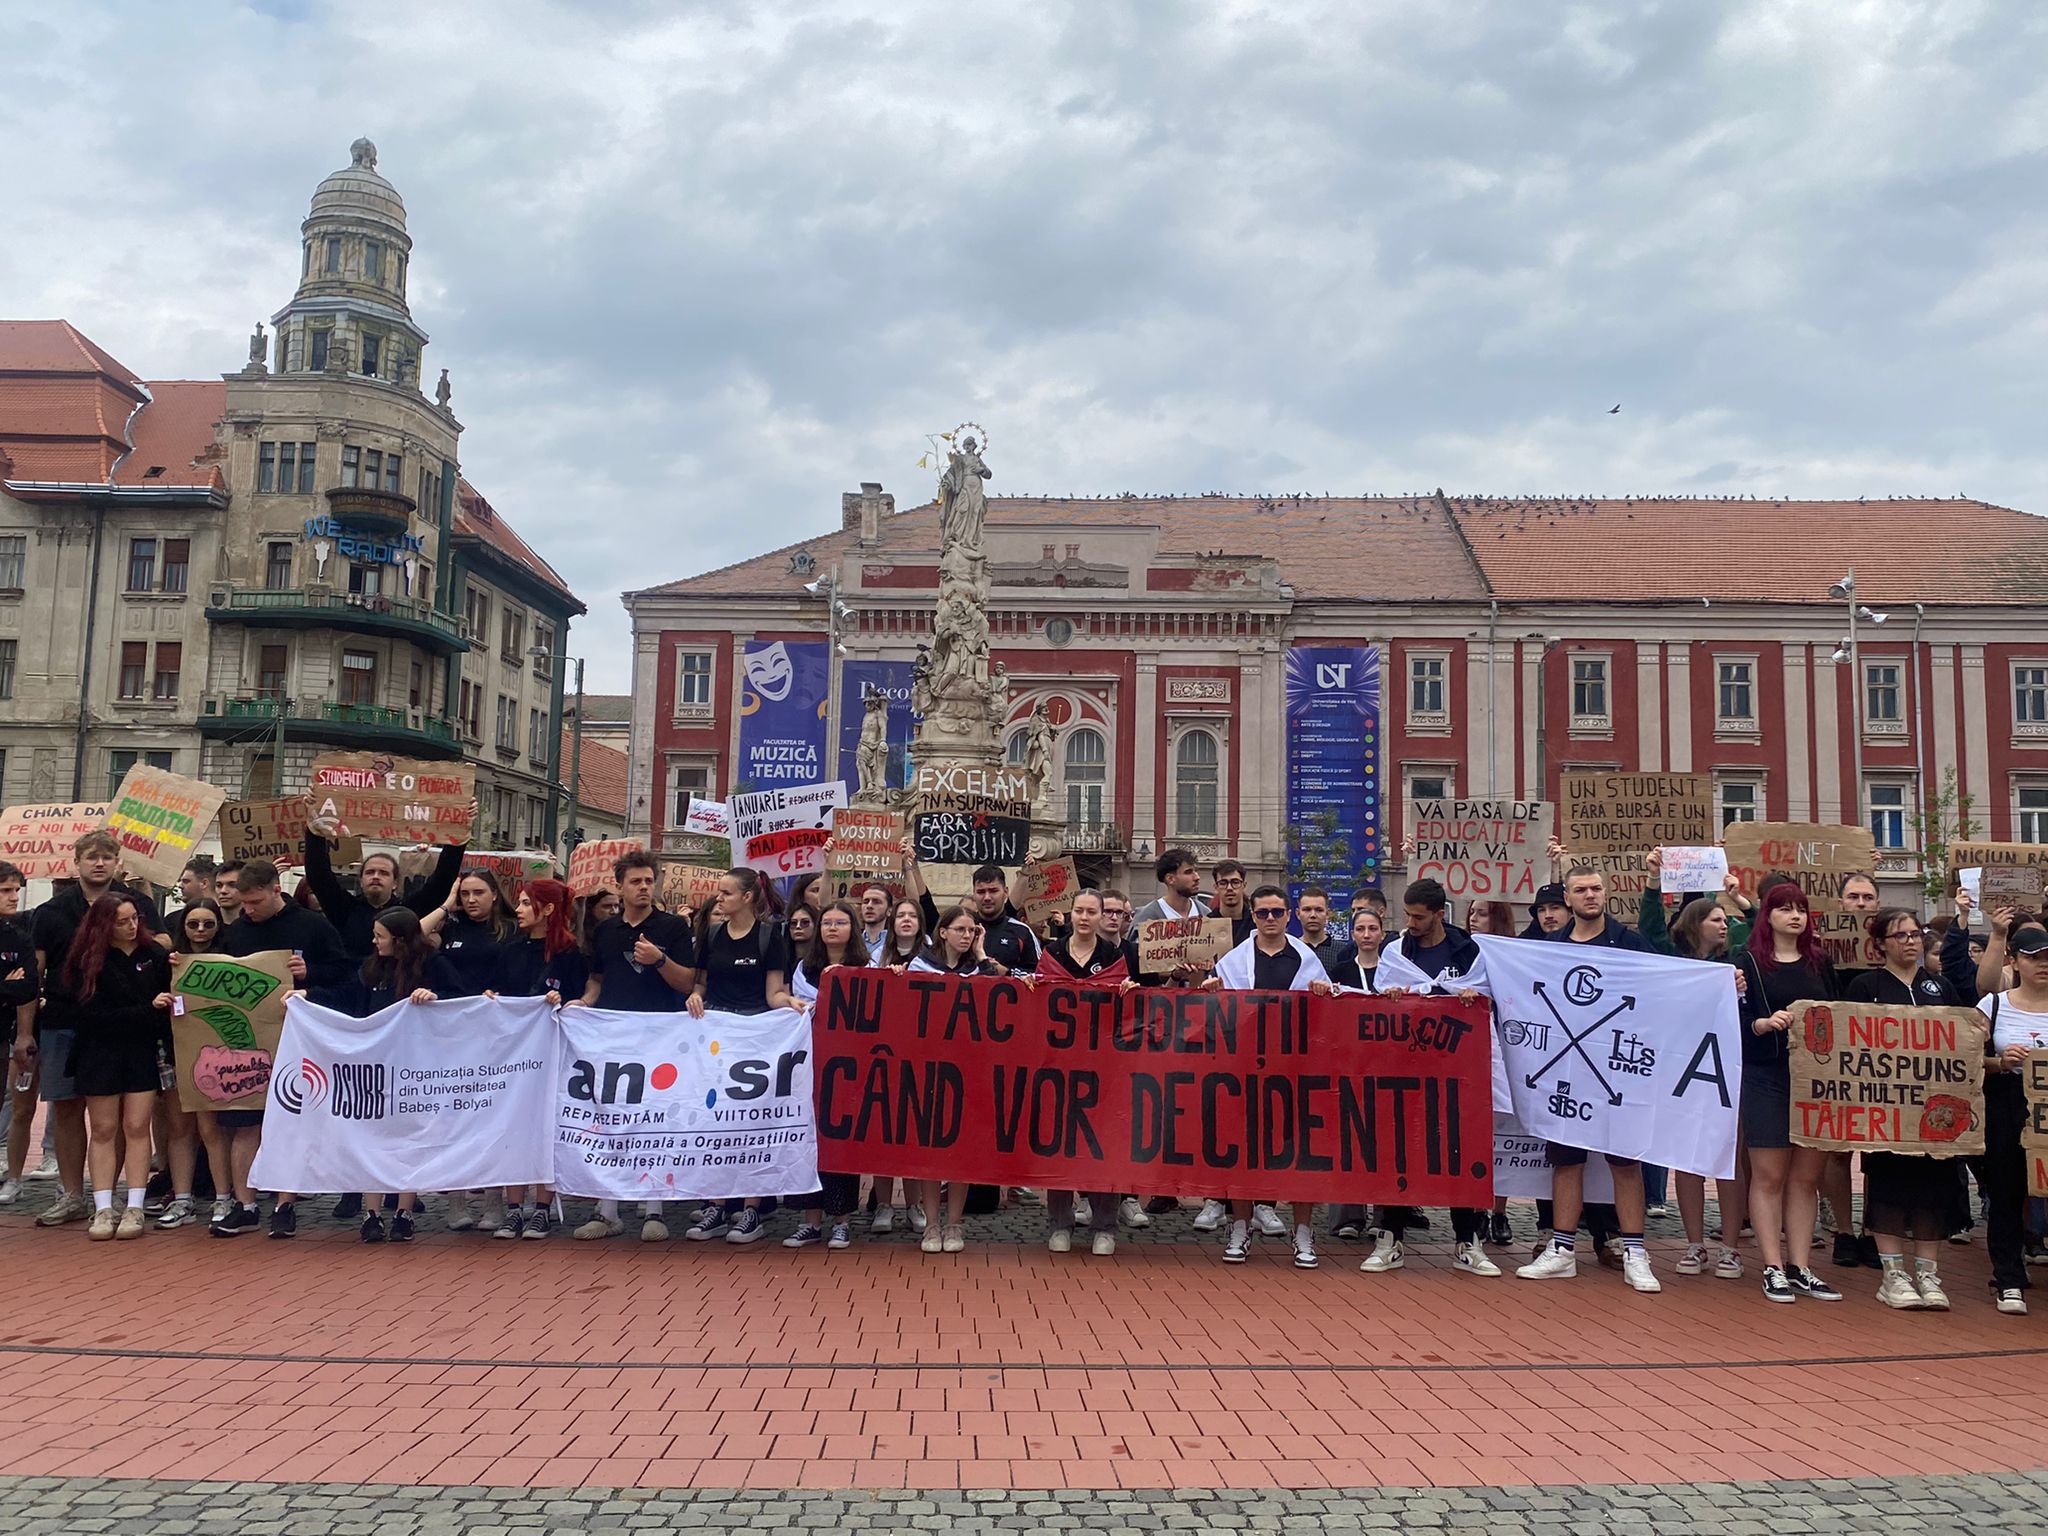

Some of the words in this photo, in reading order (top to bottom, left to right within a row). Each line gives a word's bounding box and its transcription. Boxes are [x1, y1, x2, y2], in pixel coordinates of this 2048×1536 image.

[750, 745, 817, 762] MUZICĂ
[753, 763, 818, 779] TEATRU
[385, 773, 397, 790] E
[401, 775, 415, 791] O
[918, 768, 1030, 802] EXCELĂM
[1569, 780, 1596, 798] UN
[1607, 777, 1698, 798] STUDENT
[319, 797, 337, 816] A
[943, 793, 955, 809] A
[1415, 800, 1445, 819] VĂ
[1454, 801, 1503, 820] PASĂ
[1512, 802, 1540, 821] DE
[1571, 801, 1606, 819] FĂRĂ
[1616, 800, 1661, 818] BURSĂ
[1668, 804, 1676, 818] E
[1683, 804, 1706, 820] UN
[230, 807, 251, 825] CU
[270, 799, 307, 821] TĂC
[7, 824, 30, 835] PE
[38, 824, 64, 834] NOI
[840, 825, 891, 840] VOSTRU
[1417, 820, 1527, 845] EDUCAȚIE
[1571, 823, 1642, 841] STUDENT
[1652, 823, 1675, 841] CU
[1682, 824, 1704, 841] UN
[58, 843, 76, 852] TO
[919, 829, 1017, 862] SPRIJIN
[1417, 841, 1470, 860] PÂNĂ
[1485, 842, 1508, 860] VĂ
[1797, 841, 1840, 867] NET
[836, 853, 890, 867] NOSTRU
[1955, 848, 2017, 864] NICIUN
[672, 865, 687, 877] CE
[1417, 858, 1535, 895] COSTĂ
[1610, 874, 1648, 892] SUNT
[182, 964, 270, 1003] BURSA
[827, 975, 884, 1033] NU
[908, 980, 1018, 1043] TAC
[1046, 988, 1309, 1069] STUDENȚII
[1849, 1015, 1956, 1051] NICIUN
[399, 1067, 474, 1082] Organizația
[478, 1060, 544, 1077] Studenților
[1609, 1060, 1653, 1077] UMC
[1672, 1032, 1733, 1109] A
[1839, 1048, 1976, 1085] RĂSPUNS,
[331, 1062, 385, 1120] OSUBB
[399, 1085, 418, 1097] din
[423, 1080, 506, 1097] Universitatea
[1811, 1079, 1852, 1101] DAR
[1859, 1081, 1925, 1106] MULTE
[399, 1101, 440, 1114] Babeș
[453, 1097, 492, 1112] Bolyai
[562, 1106, 665, 1126] REPREZENTĂM
[714, 1105, 801, 1122] VIITORUL!
[818, 1043, 965, 1148] CÂND
[993, 1064, 1104, 1160] VOR
[1130, 1071, 1487, 1192] DECIDENȚII.
[1795, 1101, 1901, 1142] TĂIERI
[560, 1130, 605, 1151] Alianța
[608, 1136, 675, 1153] Națională
[680, 1139, 688, 1148] a
[695, 1131, 805, 1150] Organizațiilor
[1503, 1139, 1547, 1154] Organ
[584, 1152, 666, 1170] Studențești
[672, 1153, 695, 1166] din
[703, 1152, 772, 1166] România
